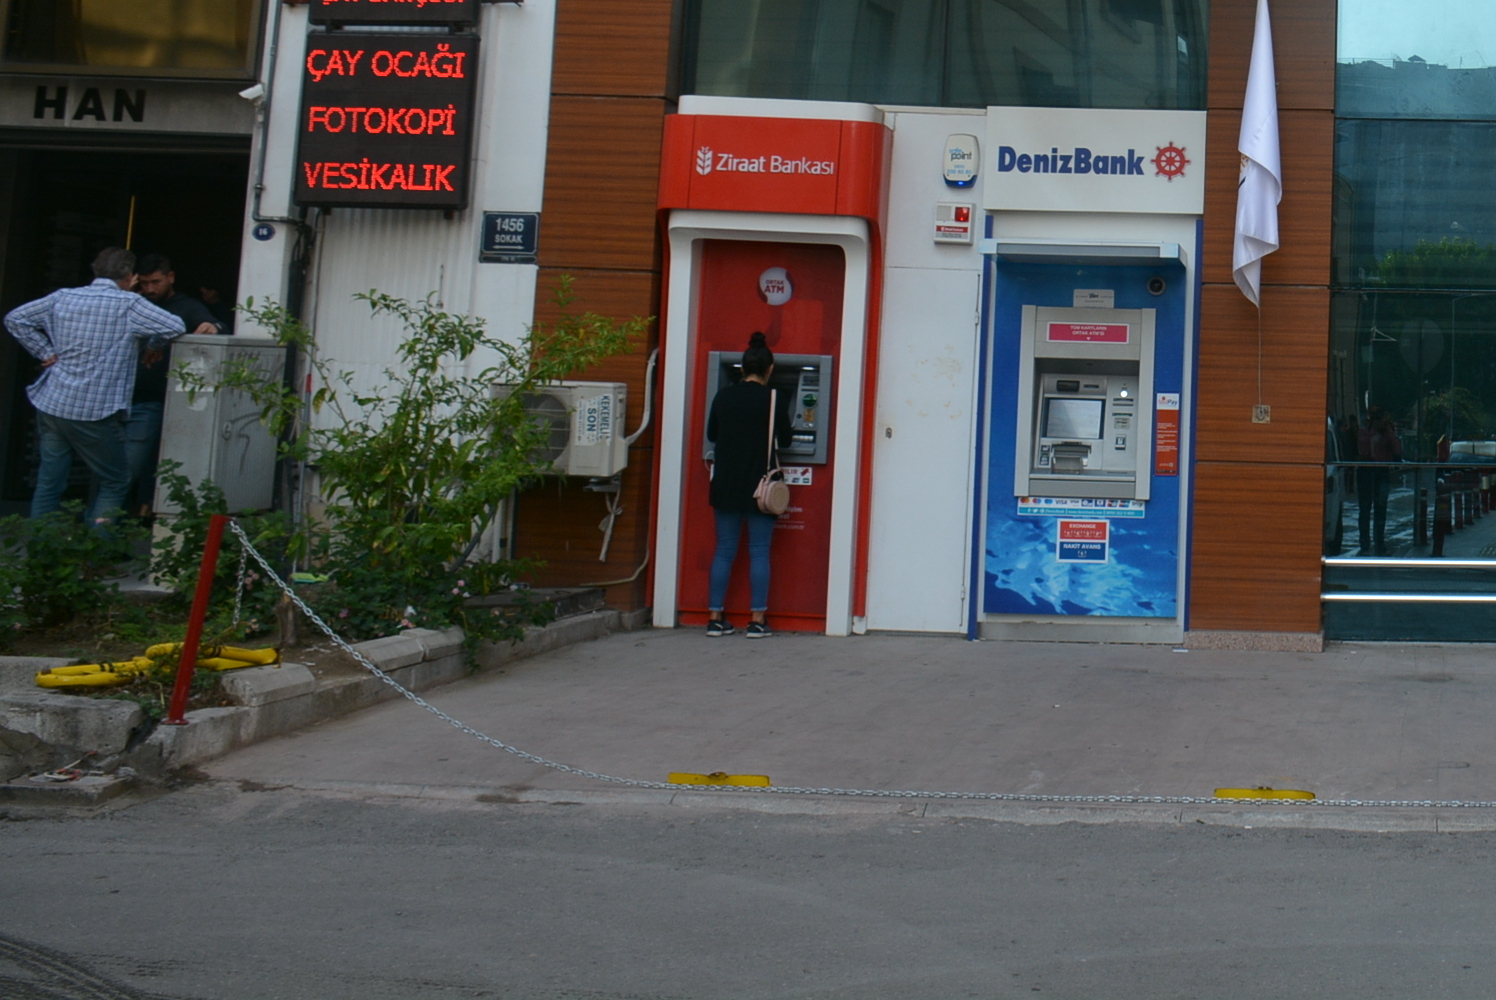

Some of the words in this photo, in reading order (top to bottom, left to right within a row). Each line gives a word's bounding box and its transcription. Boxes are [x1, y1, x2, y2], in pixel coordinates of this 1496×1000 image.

[306, 49, 364, 83] ÇAY
[371, 43, 466, 78] OCAĞI
[33, 85, 147, 123] HAN
[308, 104, 457, 136] FOTOKOPİ
[715, 153, 767, 173] Ziraat
[770, 155, 835, 175] Bankası
[950, 151, 972, 162] point
[997, 146, 1146, 176] DenizBank
[303, 157, 456, 192] VESİKALIK
[495, 217, 525, 232] 1456
[494, 233, 523, 244] SOKAK
[764, 284, 785, 294] ATM
[586, 407, 597, 432] SON
